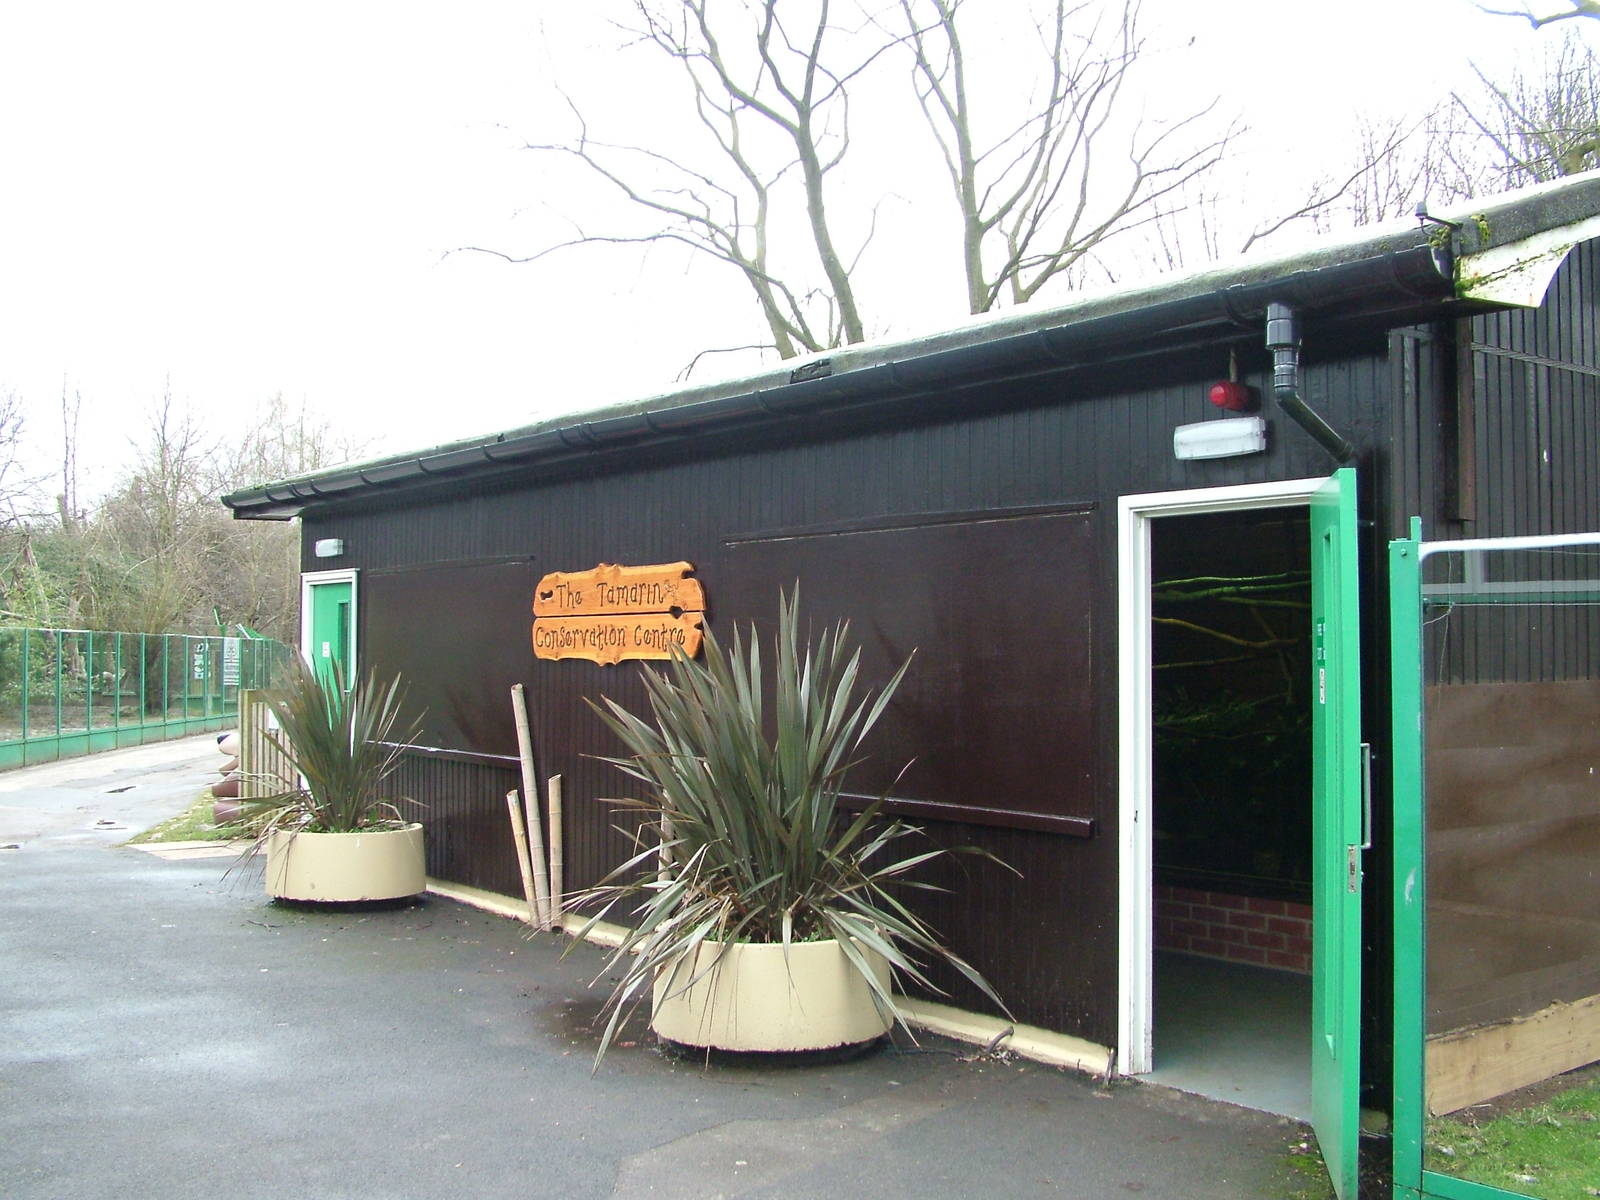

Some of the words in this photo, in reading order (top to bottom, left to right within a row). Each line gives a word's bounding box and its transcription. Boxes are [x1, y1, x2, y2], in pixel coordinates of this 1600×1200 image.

[555, 581, 583, 609] The
[596, 581, 665, 607] Tamarin
[535, 624, 627, 651] Conservation
[634, 623, 686, 652] Centre
